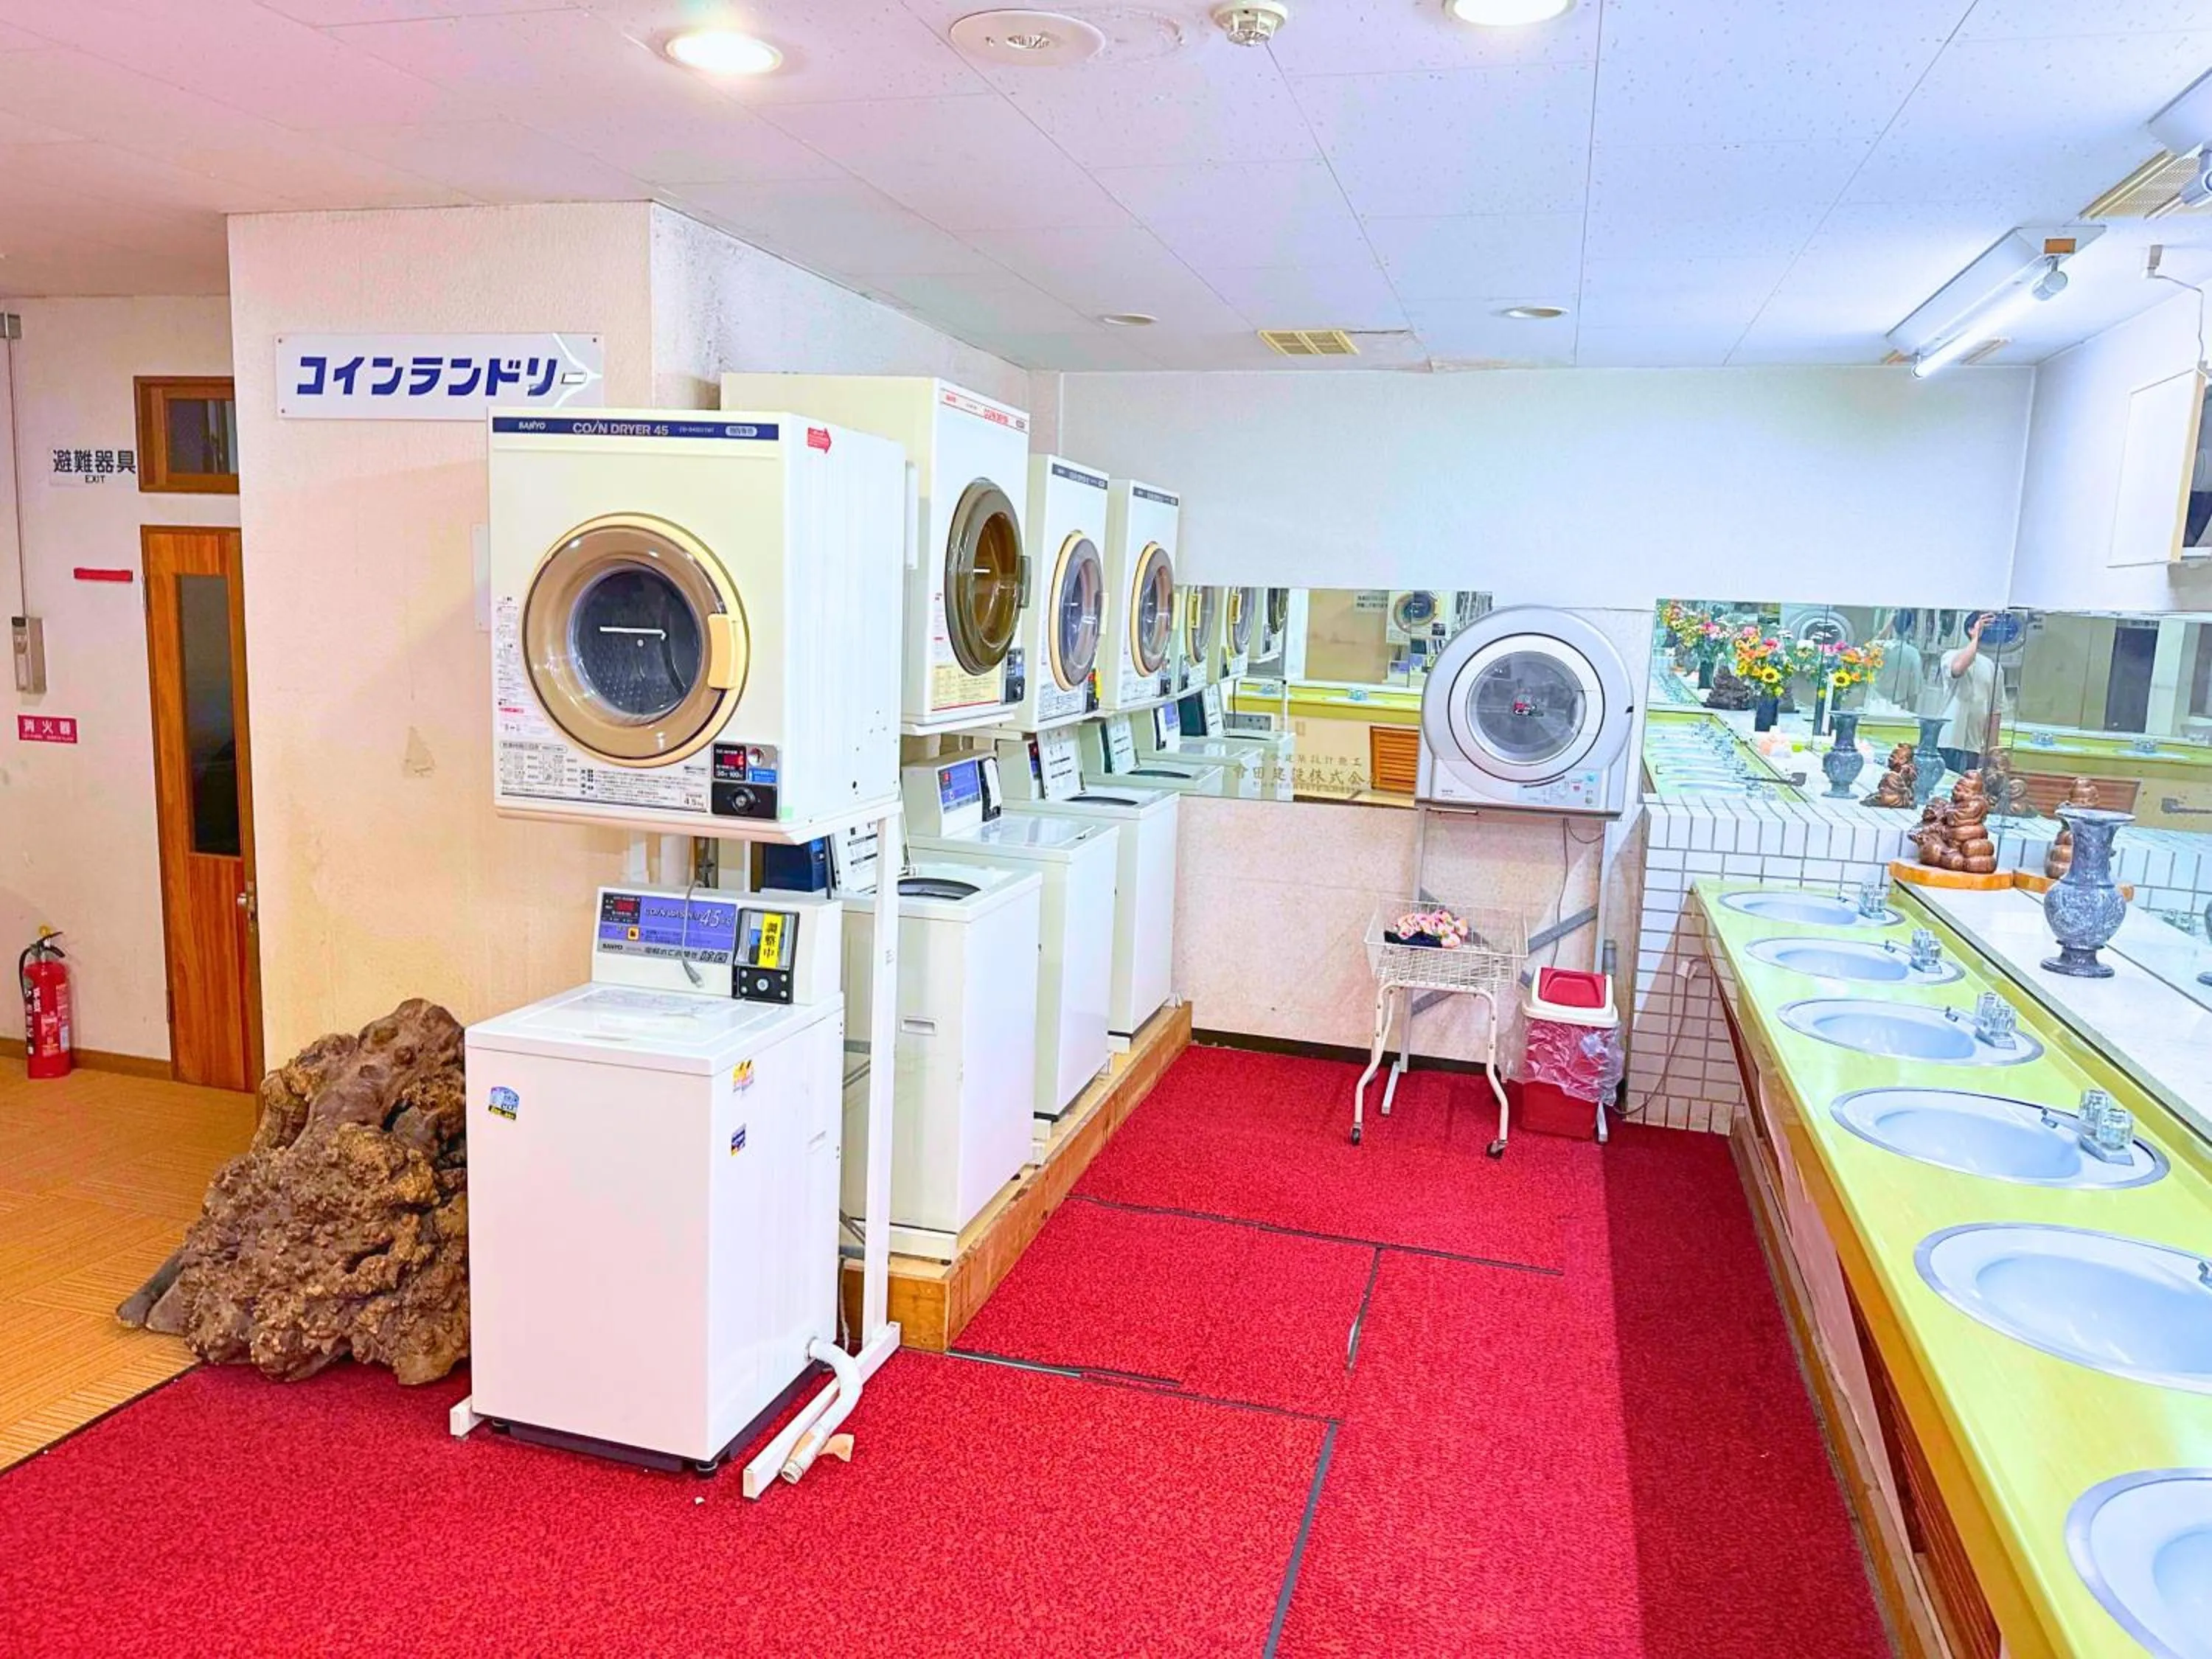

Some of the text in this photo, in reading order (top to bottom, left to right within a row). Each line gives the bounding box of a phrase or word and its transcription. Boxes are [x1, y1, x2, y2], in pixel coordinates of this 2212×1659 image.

[518, 421, 546, 430] SANYO
[611, 423, 651, 435] DRYER
[653, 425, 669, 436] 45
[53, 450, 136, 473] 避難器具
[85, 475, 105, 483] EXIT
